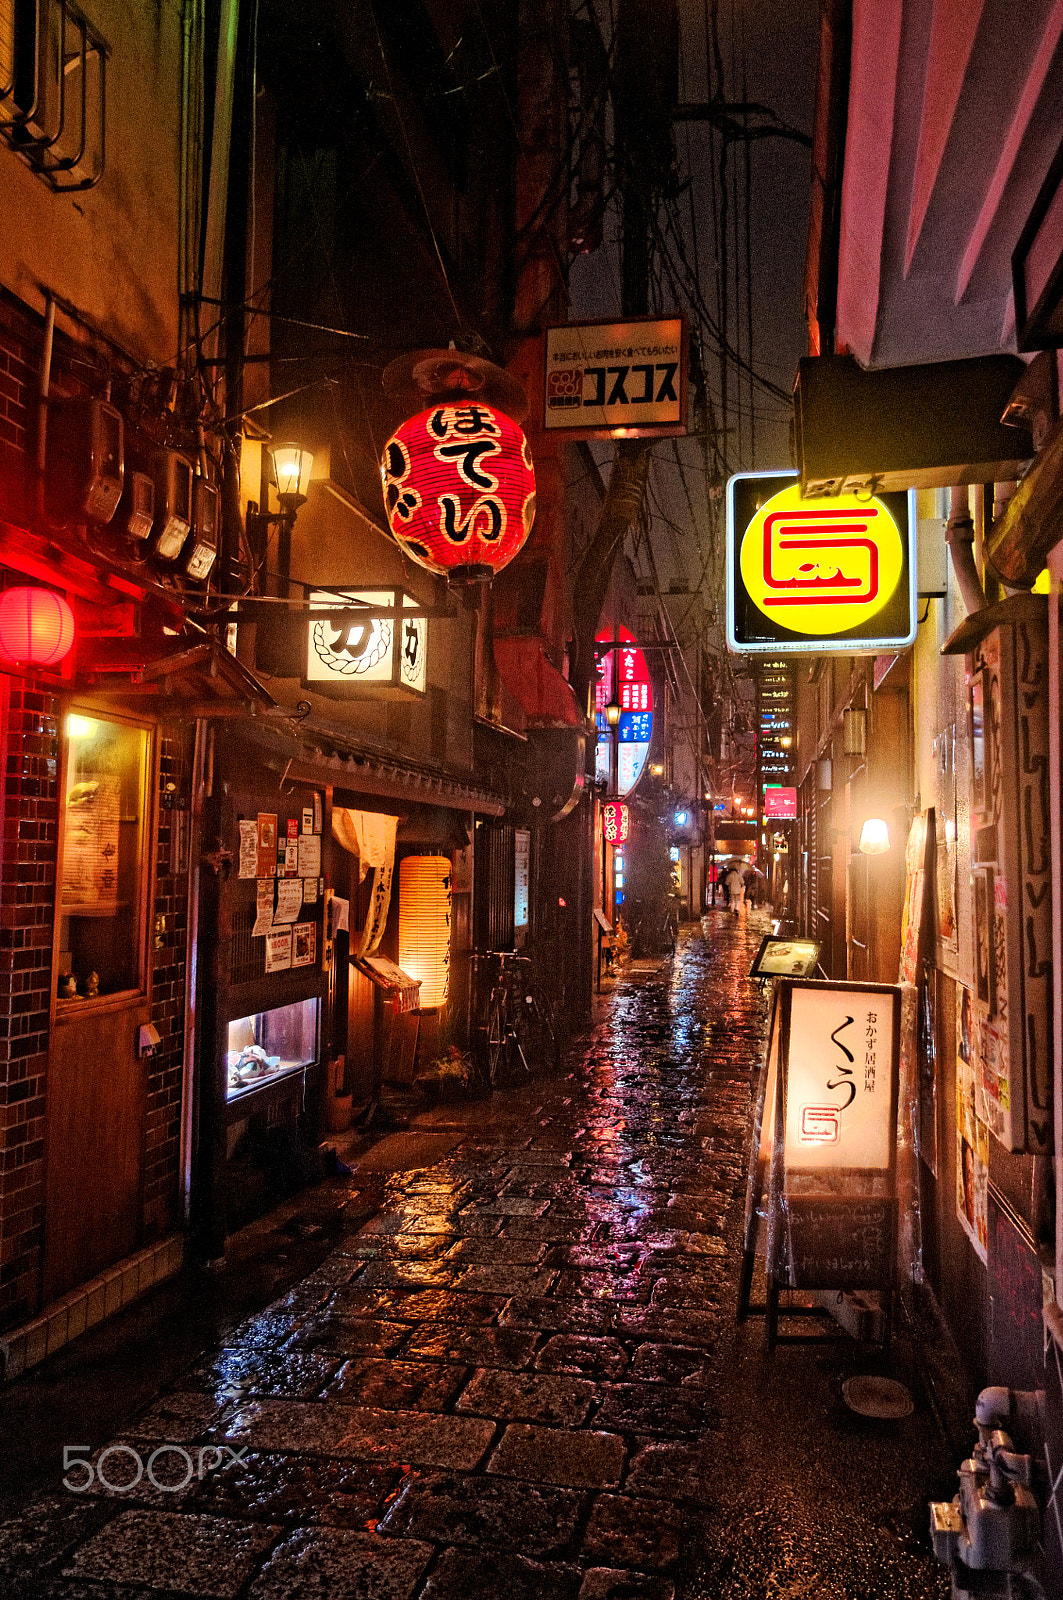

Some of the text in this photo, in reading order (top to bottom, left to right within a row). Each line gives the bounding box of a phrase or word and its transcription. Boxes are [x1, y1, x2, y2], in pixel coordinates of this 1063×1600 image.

[583, 363, 679, 406] コスコス
[428, 405, 506, 545] ほてい
[826, 1015, 856, 1112] くう
[863, 1011, 878, 1093] おかず居酒屋
